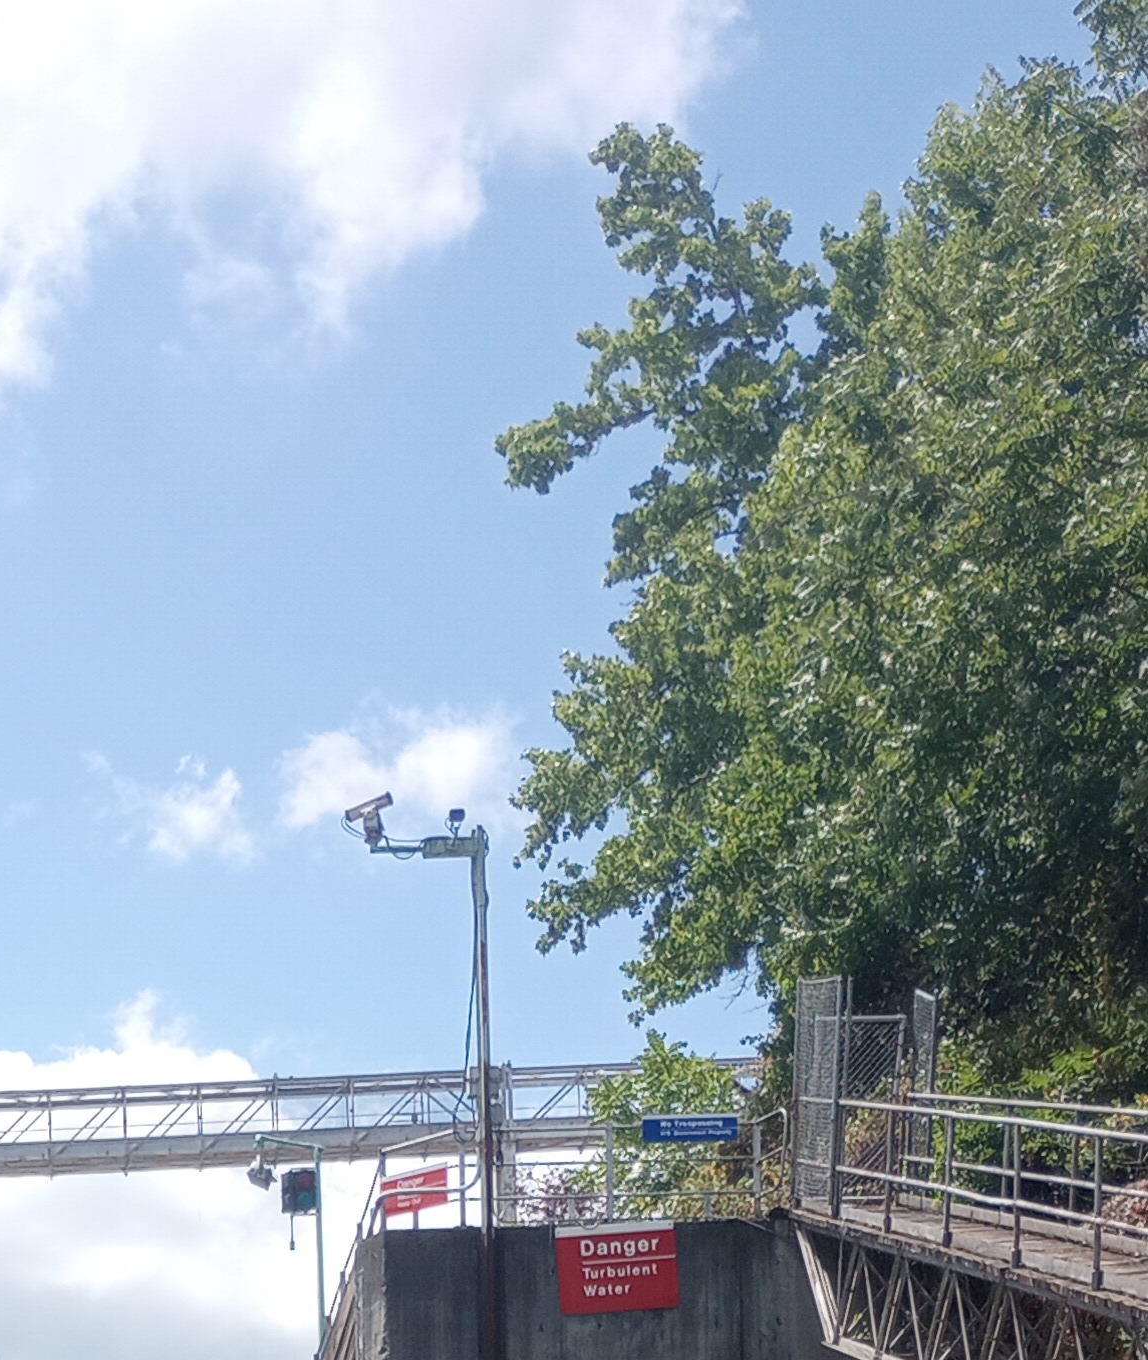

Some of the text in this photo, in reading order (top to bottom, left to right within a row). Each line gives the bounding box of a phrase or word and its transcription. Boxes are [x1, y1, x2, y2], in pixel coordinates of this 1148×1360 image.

[580, 1238, 660, 1257] Danger
[582, 1263, 658, 1280] Turbulent
[583, 1283, 631, 1297] Water
